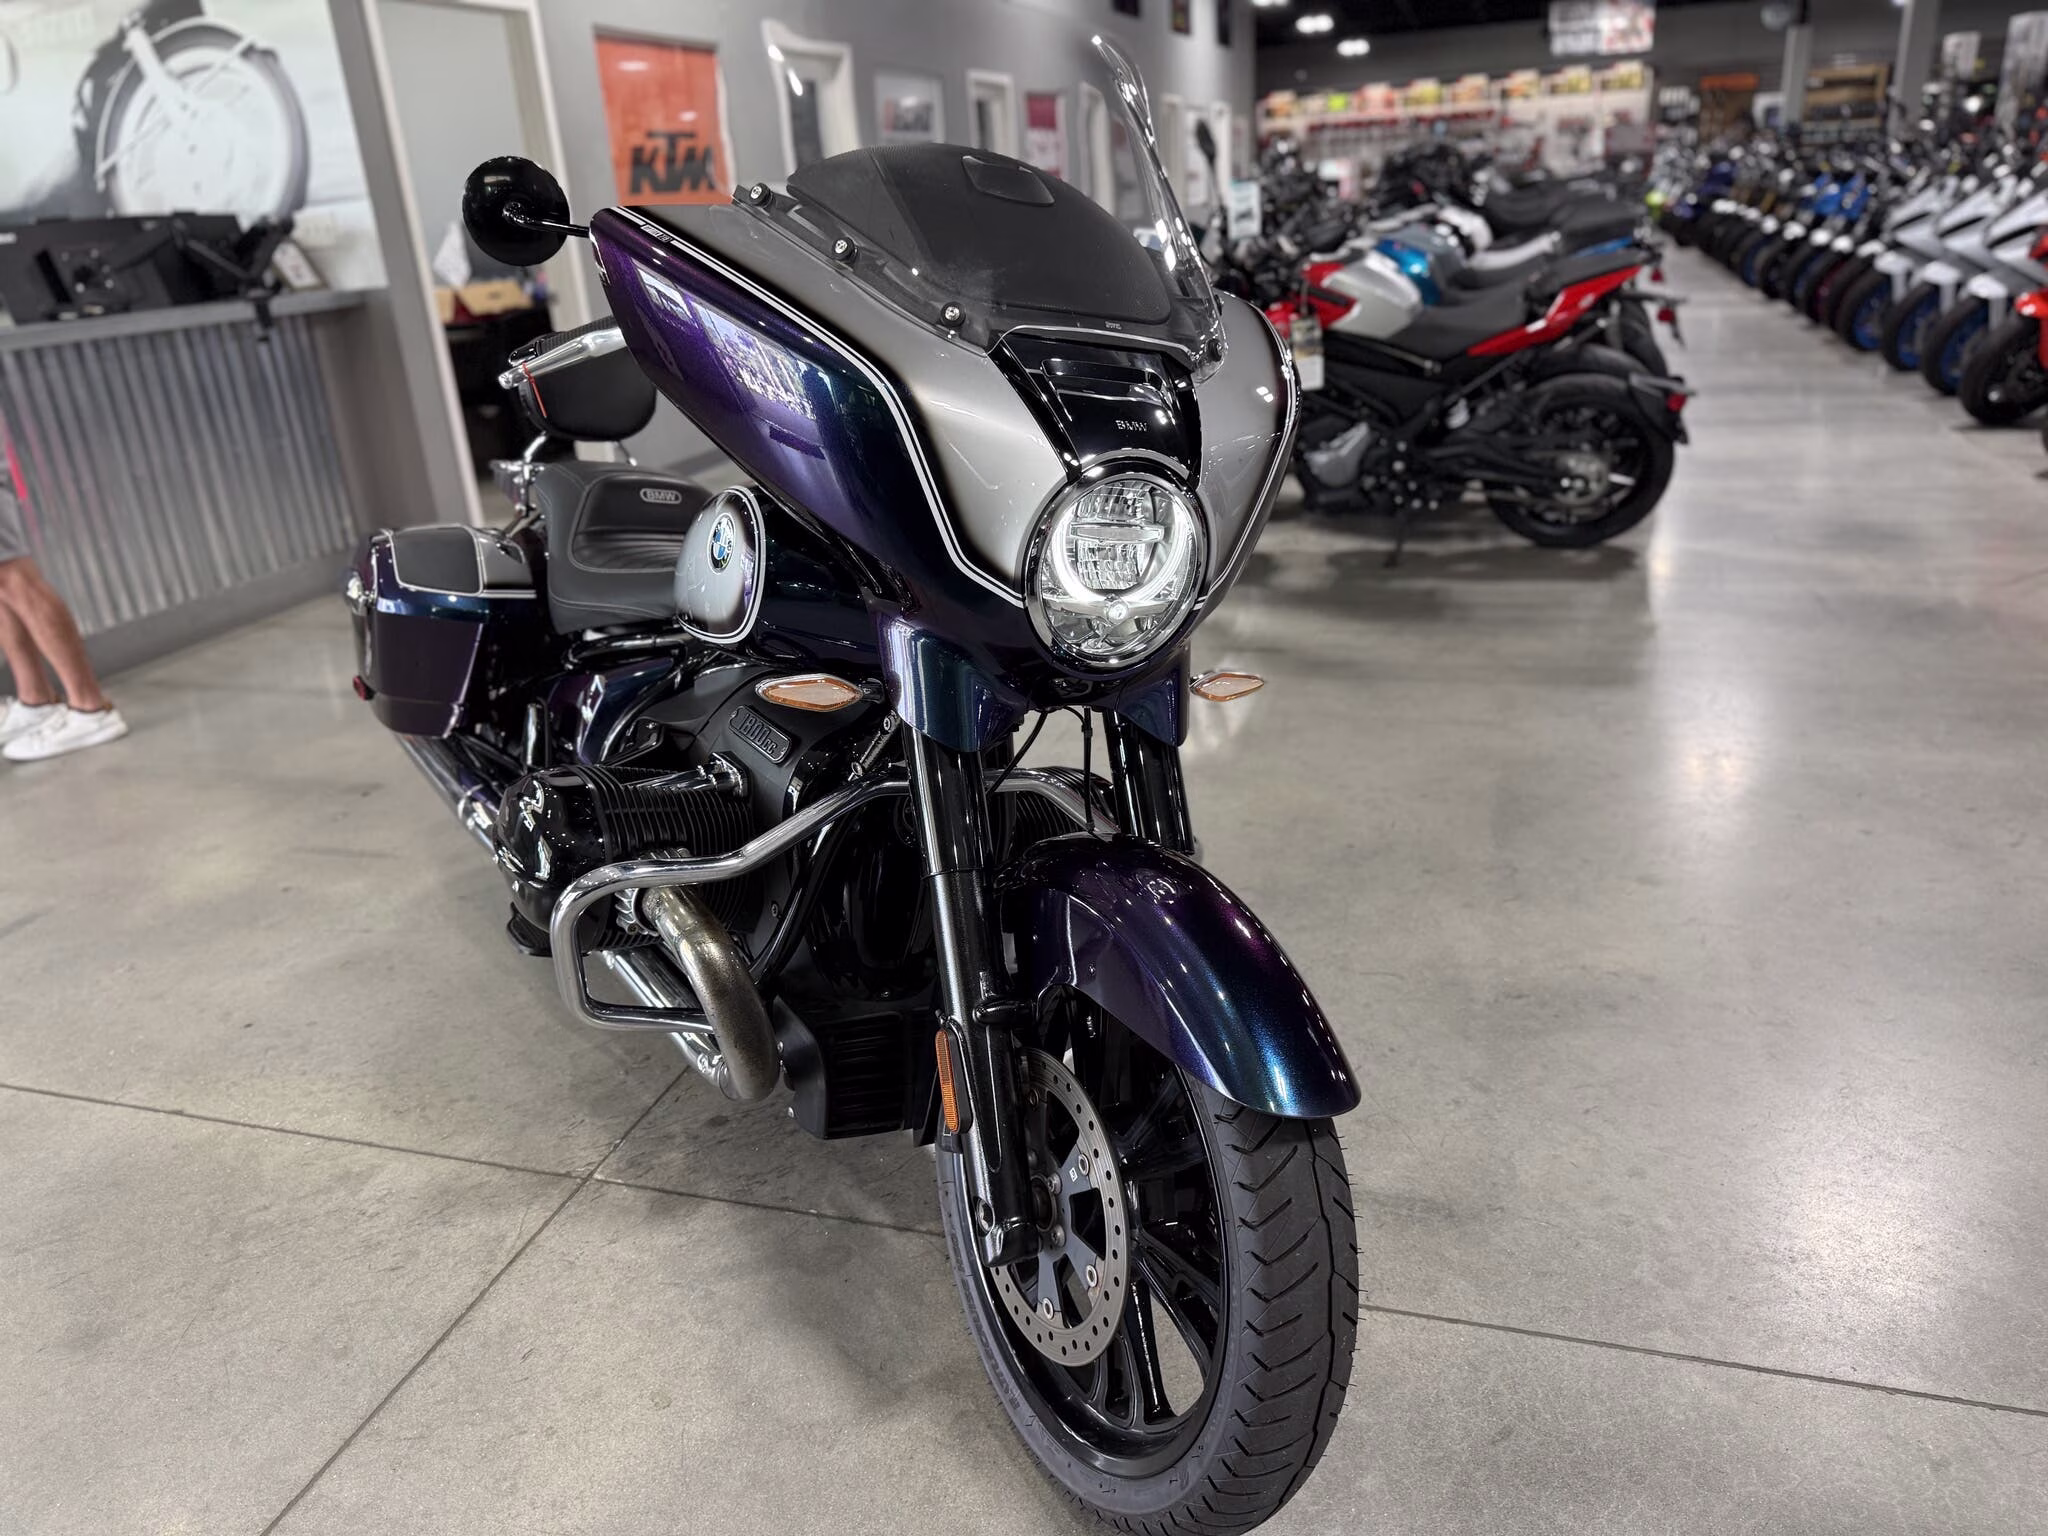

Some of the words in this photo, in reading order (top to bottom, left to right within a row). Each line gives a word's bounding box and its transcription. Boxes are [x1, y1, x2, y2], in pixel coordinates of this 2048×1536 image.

[630, 131, 715, 194] KTM
[1115, 420, 1147, 431] BMW
[646, 490, 677, 501] BMW
